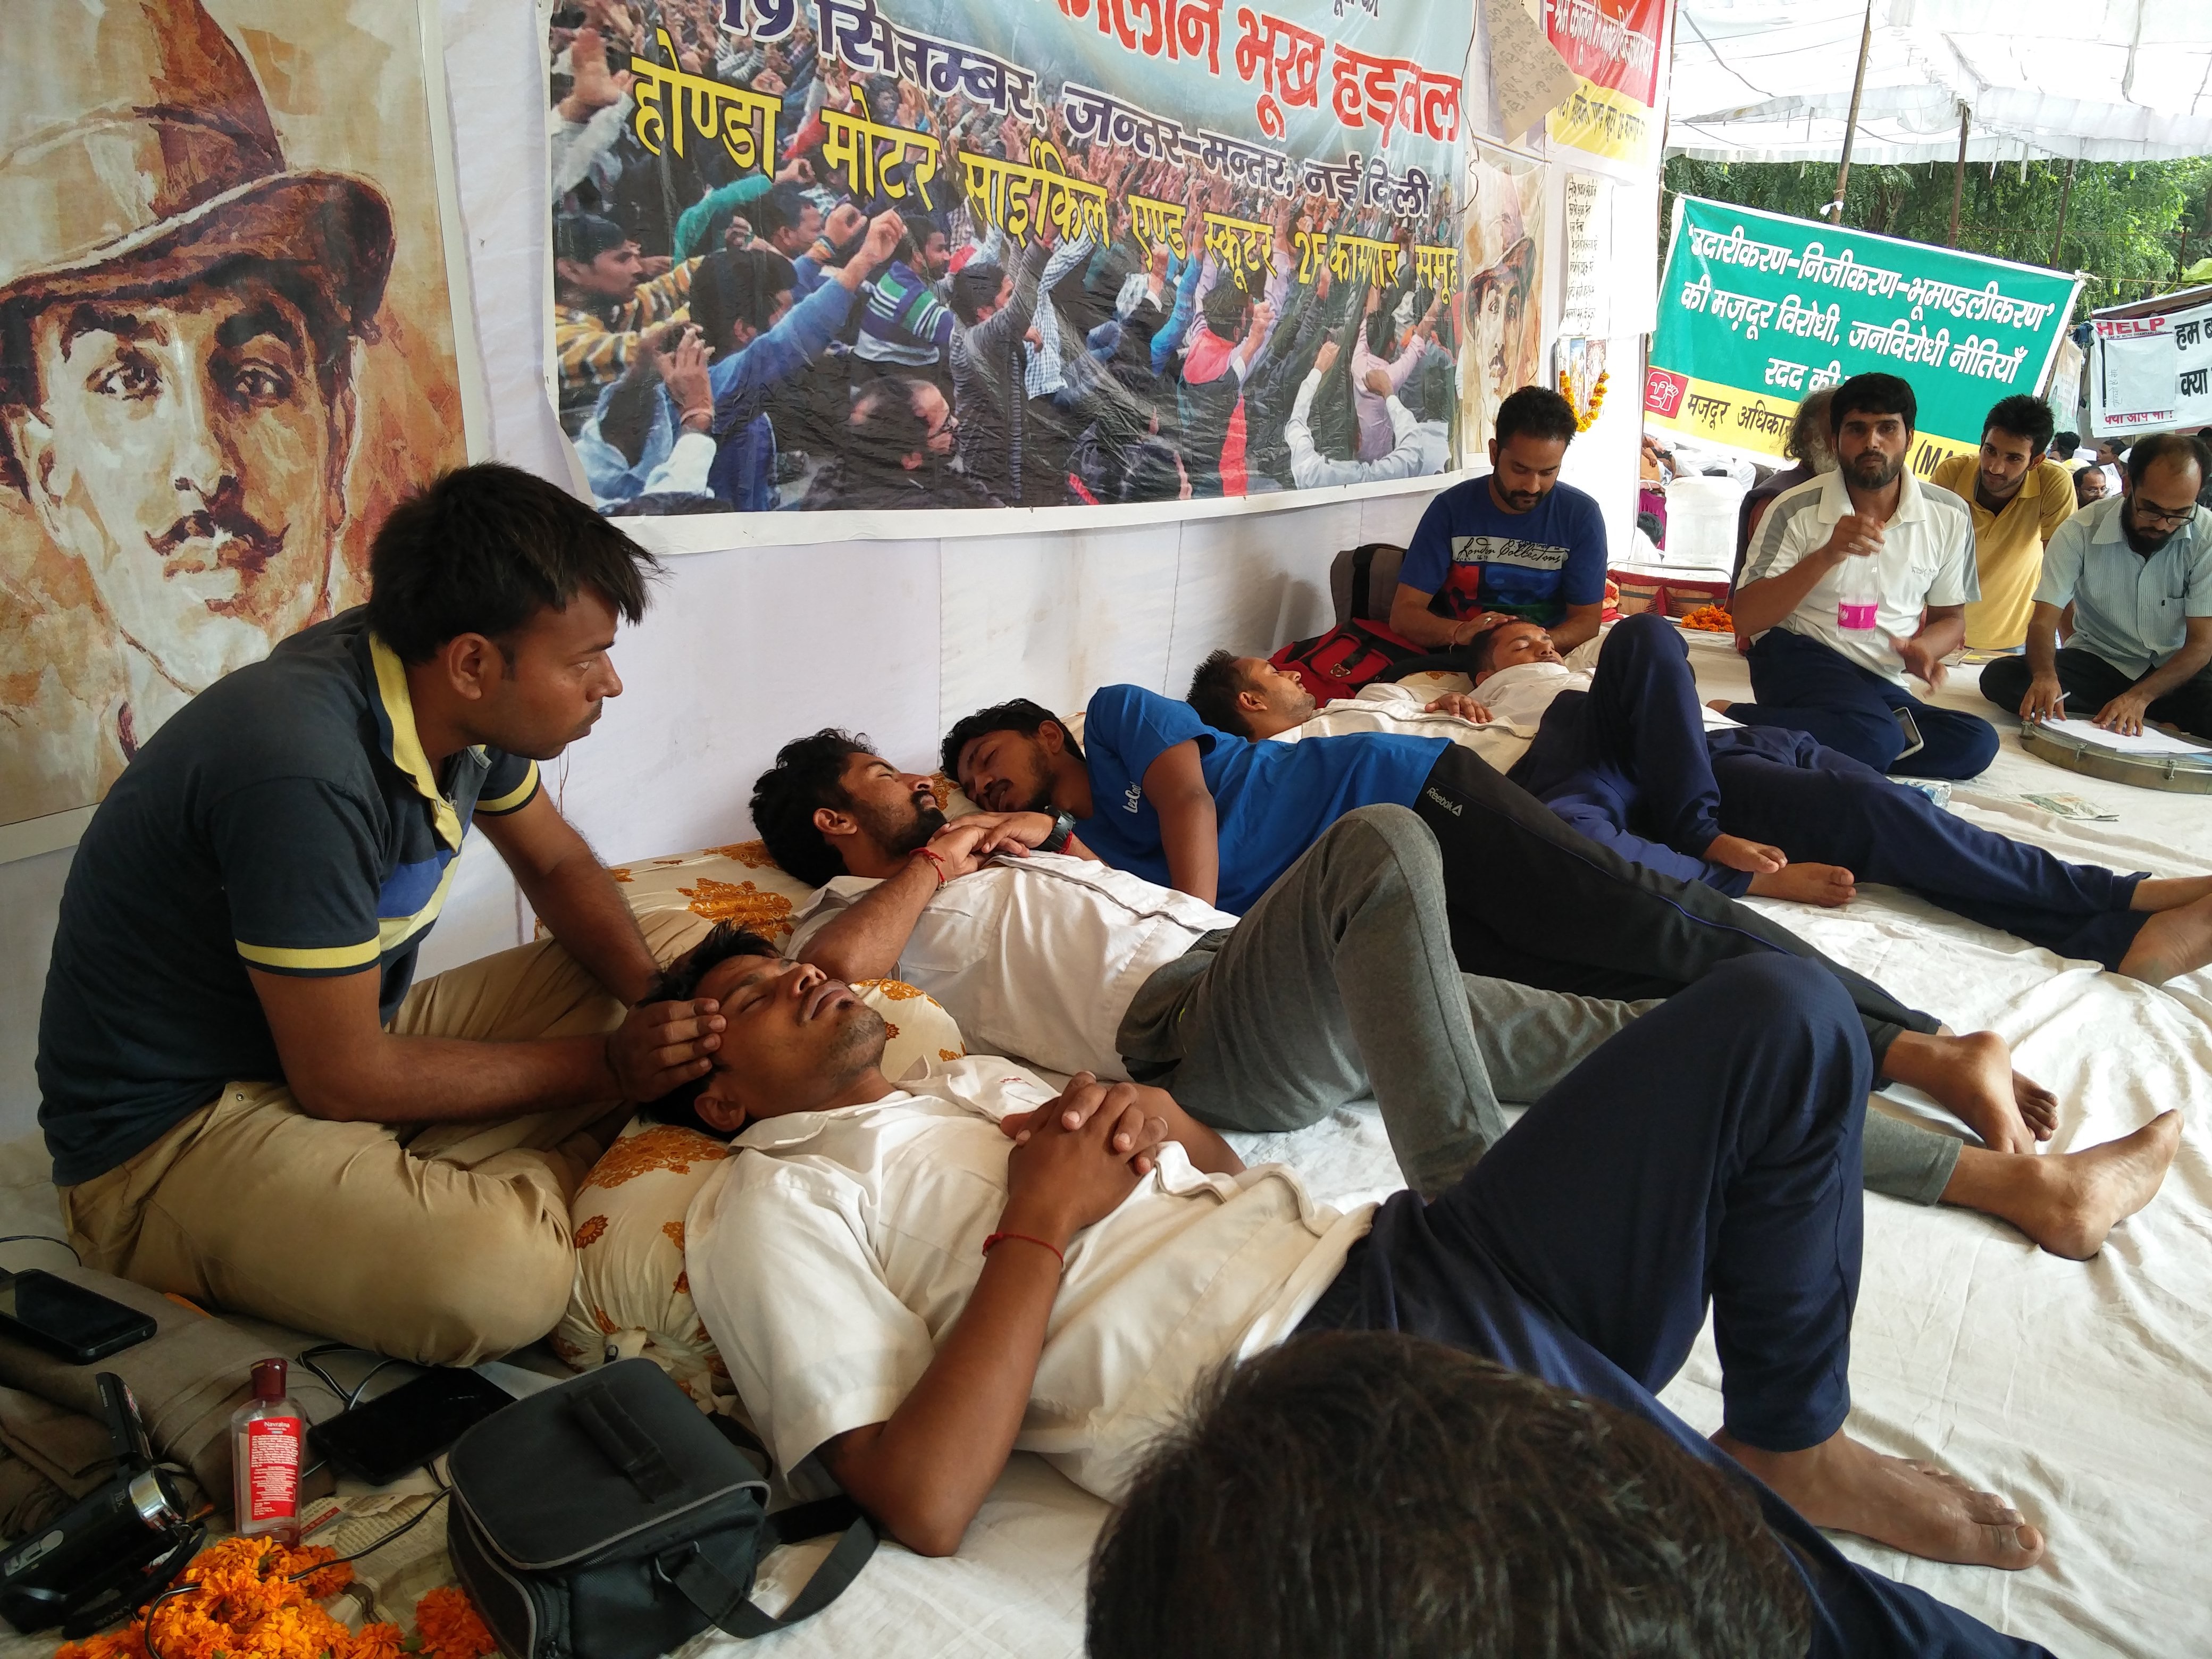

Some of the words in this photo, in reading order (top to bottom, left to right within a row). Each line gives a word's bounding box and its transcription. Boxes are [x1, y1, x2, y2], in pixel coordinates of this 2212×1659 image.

[1235, 7, 1325, 139] भूख
[722, 0, 797, 41] 19
[814, 0, 1046, 132] सितम्बर,
[1063, 83, 1295, 200] जन्तर-मन्तर,
[1303, 153, 1363, 209] नई
[631, 27, 782, 181] होण्डा
[820, 82, 941, 211] मोटर
[1128, 194, 1186, 272] एण्ड
[1203, 212, 1277, 293] स्कूटर
[1295, 232, 1328, 284] 2F
[1414, 245, 1459, 307] समूह
[1681, 273, 1711, 313] की
[1711, 289, 1778, 341] मज़दूर
[1774, 294, 1840, 347] विरोधी,
[1849, 319, 1950, 367] जनविरोधी
[1949, 334, 2029, 384] नीतियाँ
[2096, 317, 2165, 336] HELP
[2174, 321, 2200, 350] हम
[1808, 359, 1841, 391] की
[2180, 368, 2208, 397] क्या
[1688, 394, 1731, 430] मज़दूर
[1737, 400, 1794, 437] अधिका
[1913, 439, 1954, 476] (M
[1457, 537, 1496, 560] London
[1426, 787, 1454, 811] Reebok
